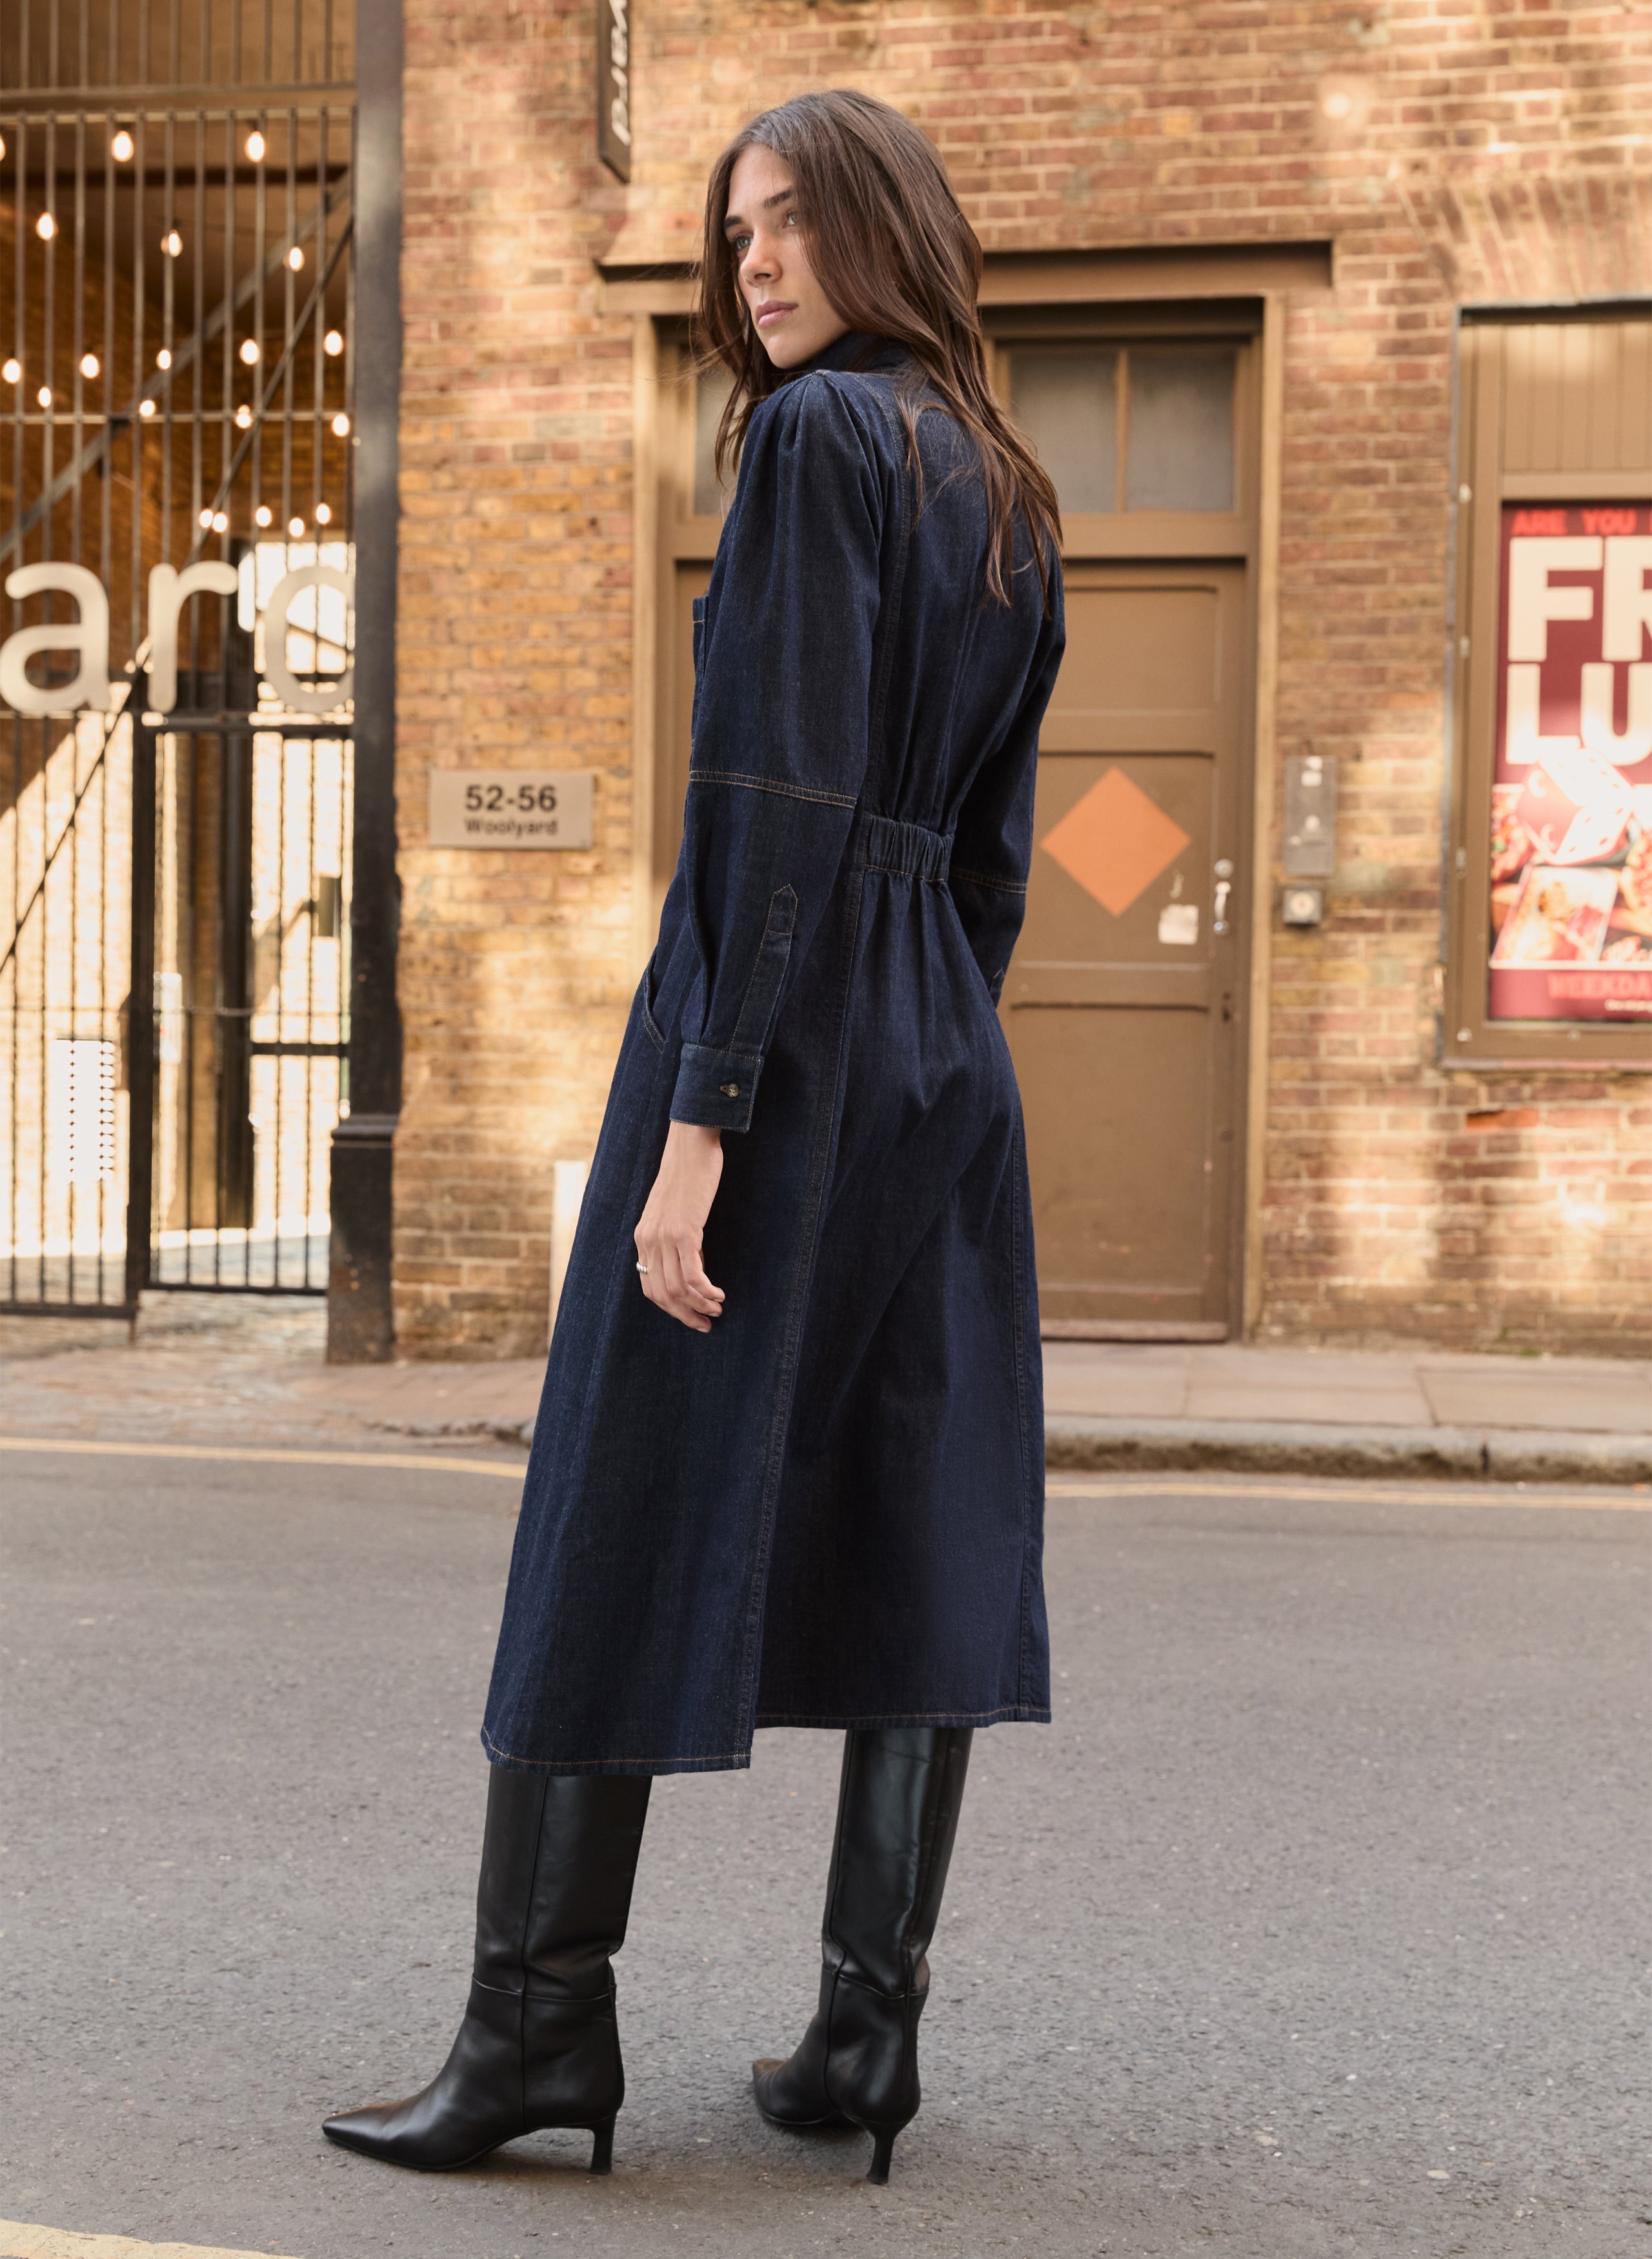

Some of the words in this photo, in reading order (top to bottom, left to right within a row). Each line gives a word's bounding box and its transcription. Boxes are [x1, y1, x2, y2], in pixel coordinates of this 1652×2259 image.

[1511, 509, 1567, 536] ARE
[1581, 508, 1637, 535] YOU
[1507, 535, 1652, 662] FR
[1506, 662, 1652, 766] LU
[465, 785, 557, 812] 52-56
[465, 818, 557, 838] Woolyard
